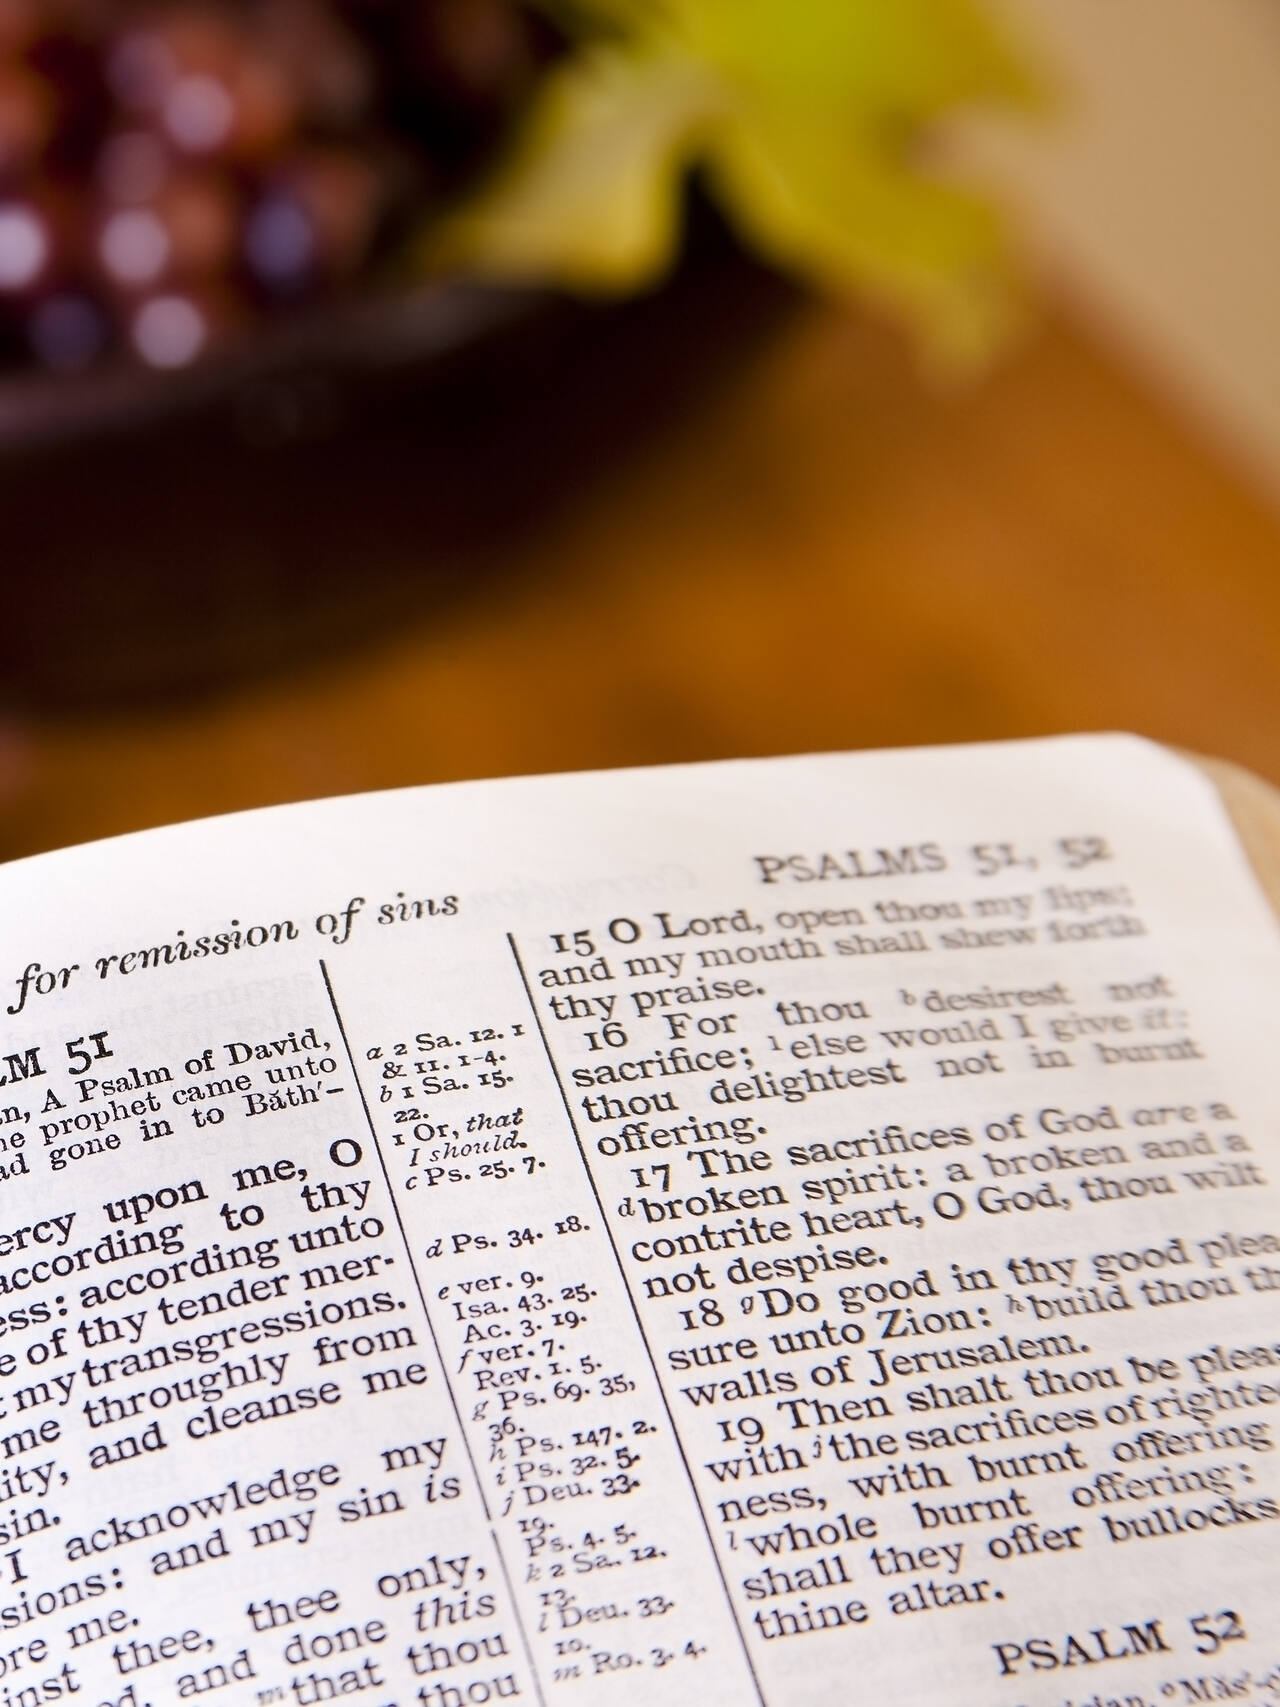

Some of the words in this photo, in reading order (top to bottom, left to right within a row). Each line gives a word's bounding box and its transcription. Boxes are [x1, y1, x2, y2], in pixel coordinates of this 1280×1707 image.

[754, 843, 948, 884] PSALMS
[1061, 836, 1116, 869] 52
[6, 962, 81, 1015] for
[94, 919, 300, 980] remission
[315, 896, 366, 945] of
[377, 891, 459, 926] sins
[549, 929, 597, 958] 15
[607, 917, 642, 945] O
[652, 909, 764, 940] Lord,
[774, 907, 868, 936] open
[548, 994, 618, 1023] thy
[629, 976, 766, 1019] praise.
[40, 1087, 68, 1114] A
[73, 1066, 175, 1104] Psalm
[184, 1048, 216, 1076] of
[222, 1027, 331, 1066] David,
[64, 1030, 115, 1076] 51
[393, 1043, 408, 1057] 2
[415, 1032, 462, 1053] Sa.
[468, 1028, 505, 1044] 12.
[38, 1090, 162, 1147] prophet
[171, 1074, 253, 1106] came
[264, 1056, 339, 1086] unto
[580, 1091, 680, 1123] thou
[709, 1058, 907, 1105] delightest
[935, 1051, 1004, 1078] not
[1032, 1044, 1075, 1070] in
[48, 1133, 122, 1172] gone
[139, 1118, 175, 1142] in
[190, 1107, 225, 1129] to
[405, 1175, 418, 1191] c
[423, 1166, 472, 1187] Ps.
[478, 1159, 516, 1180] 25.
[521, 1155, 546, 1175] 7.
[629, 1163, 671, 1193] 17
[686, 1147, 773, 1179] The
[786, 1125, 974, 1167] sacrifices
[985, 1113, 1027, 1142] of
[1038, 1106, 1120, 1135] God
[102, 1179, 210, 1226] upon
[231, 1159, 308, 1192] me,
[328, 1138, 363, 1168] O
[219, 1202, 265, 1232] to
[300, 1179, 372, 1213] thy
[425, 1238, 444, 1260] d
[450, 1233, 498, 1255] Ps.
[507, 1227, 544, 1249] 34.
[554, 1215, 591, 1236] 18.
[631, 1216, 793, 1263] contrite
[799, 1199, 925, 1238] heart,
[932, 1191, 967, 1221] O
[976, 1182, 1071, 1215] God,
[1078, 1176, 1175, 1203] thou
[79, 1238, 281, 1309] according
[287, 1214, 385, 1254] unto
[437, 1286, 450, 1301] e
[456, 1275, 513, 1295] ver.
[520, 1270, 545, 1290] 9.
[641, 1262, 717, 1300] not
[726, 1243, 889, 1286] despise.
[26, 1327, 69, 1366] of
[77, 1310, 148, 1349] thy
[157, 1273, 291, 1326] tender
[299, 1254, 395, 1291] mer-
[451, 1301, 510, 1322] Isa.
[517, 1292, 554, 1313] 43.
[560, 1282, 598, 1303] 25.
[679, 1367, 799, 1407] walls
[810, 1354, 855, 1388] of
[866, 1334, 1091, 1388] Jerusalem.
[716, 1416, 765, 1446] 19
[776, 1395, 895, 1430] Then
[905, 1373, 1014, 1413] shalt
[1022, 1367, 1124, 1398] thou
[1125, 1356, 1180, 1384] be
[150, 1527, 231, 1577] and
[248, 1509, 316, 1548] my
[337, 1487, 406, 1523] sin
[424, 1473, 461, 1504] is
[742, 1554, 853, 1601] shall
[869, 1542, 964, 1577] they
[987, 1522, 1083, 1560] offer
[1100, 1496, 1280, 1543] bullocks
[111, 1629, 215, 1676] thee,
[246, 1589, 340, 1633] thee
[376, 1555, 486, 1598] only,
[753, 1600, 870, 1640] thine
[888, 1579, 1005, 1616] altar.
[991, 1619, 1172, 1677] PSALM
[1189, 1610, 1246, 1656] 52
